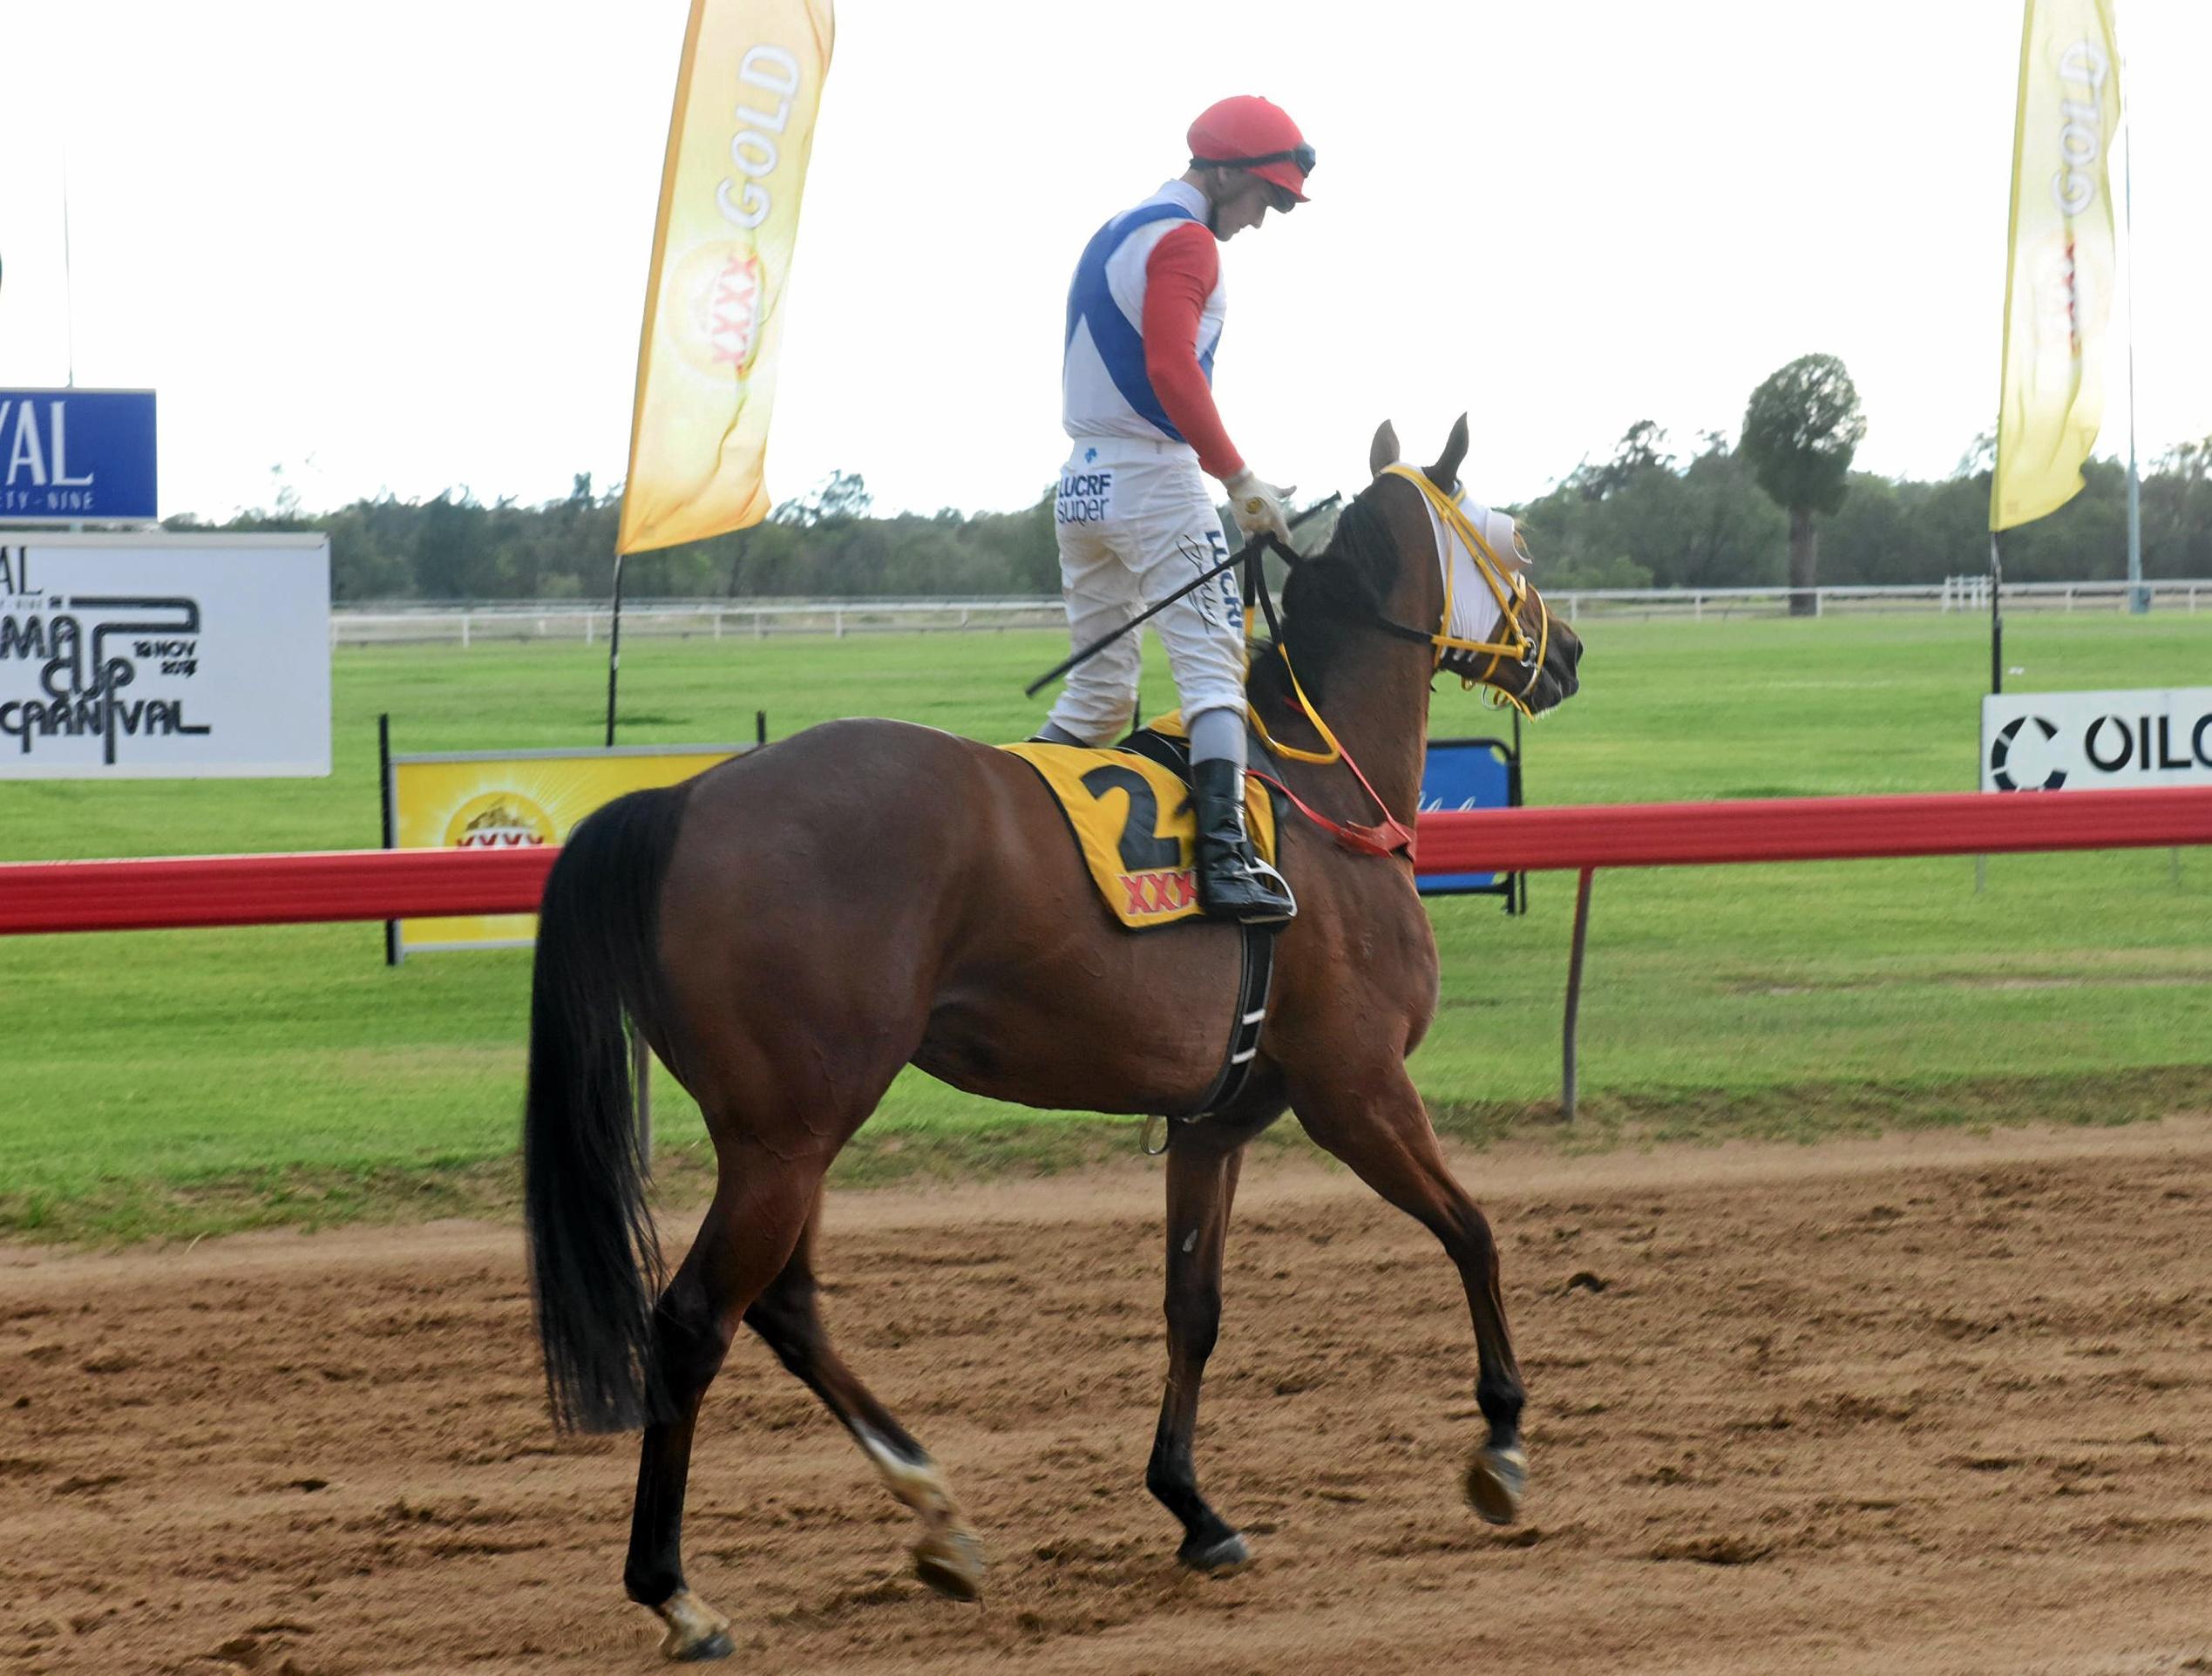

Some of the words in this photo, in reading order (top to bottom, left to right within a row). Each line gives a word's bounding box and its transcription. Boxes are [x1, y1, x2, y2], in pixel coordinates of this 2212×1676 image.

[716, 44, 800, 230] GOLD
[2052, 40, 2109, 215] GOLD
[1057, 499, 1109, 527] super
[1059, 474, 1112, 498] LUCRF
[1081, 764, 1181, 872] 2
